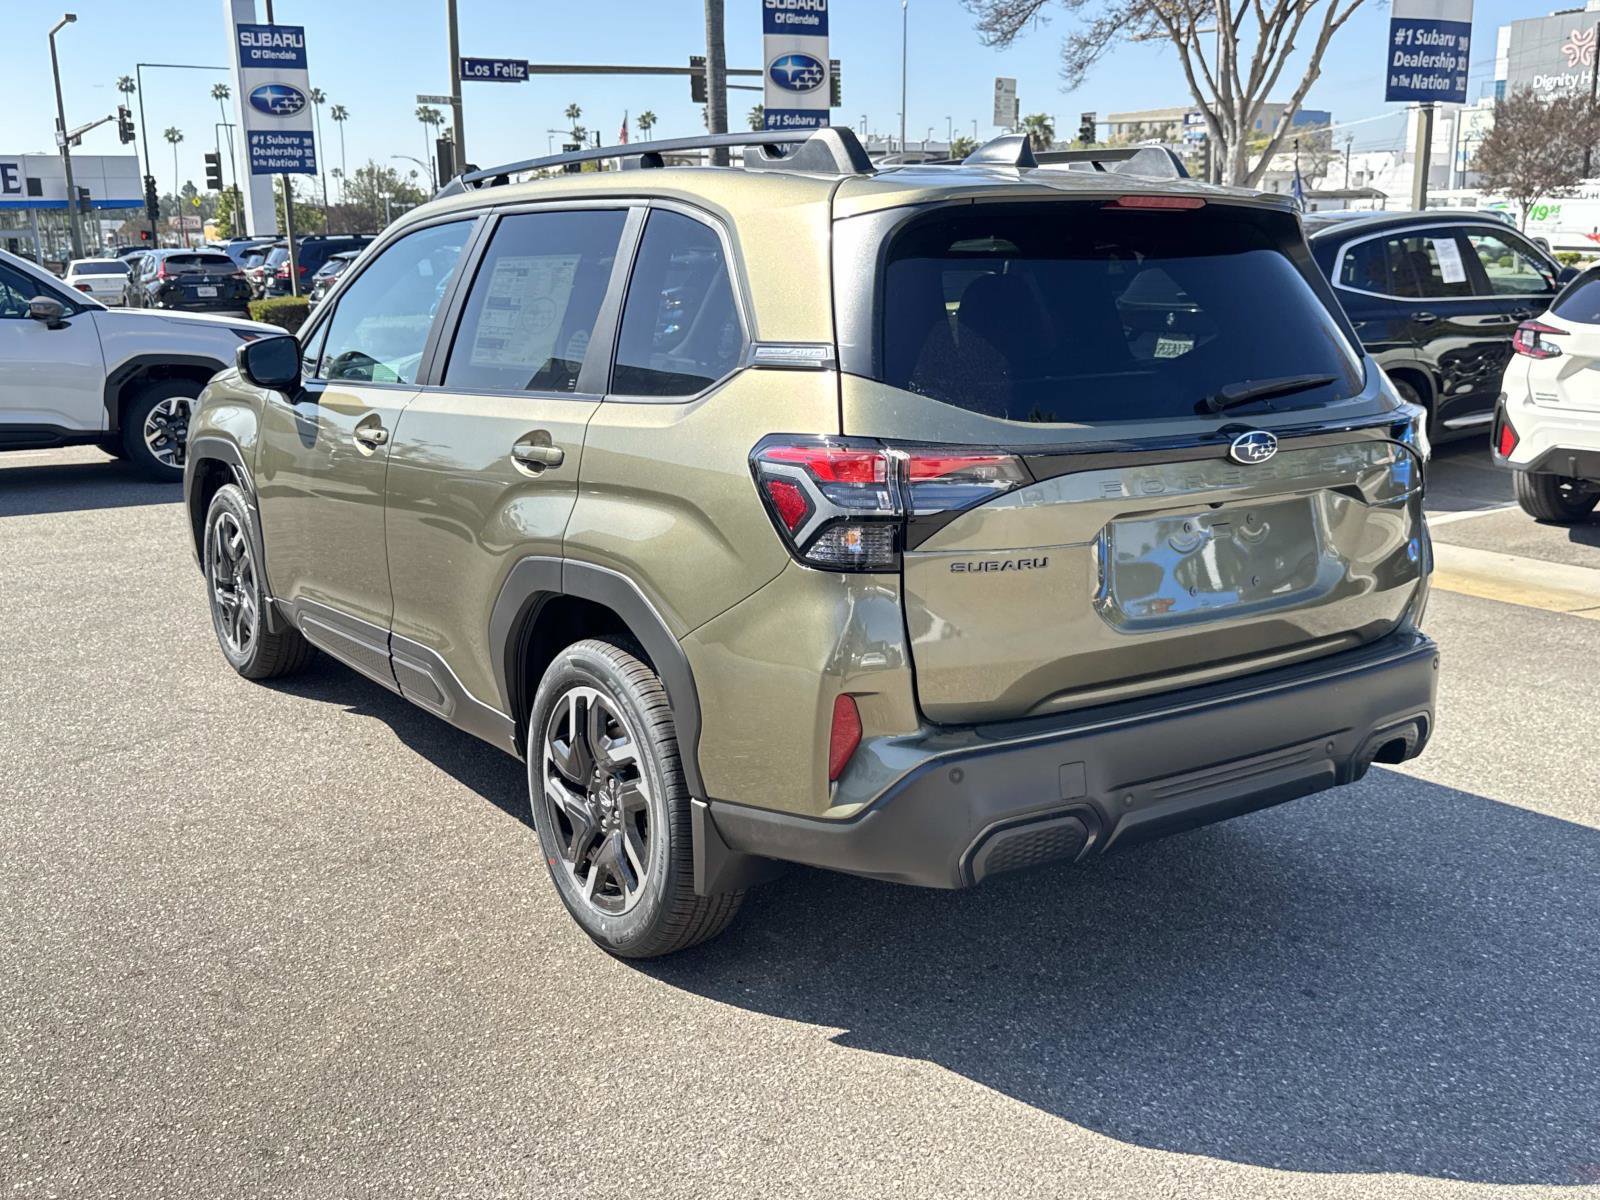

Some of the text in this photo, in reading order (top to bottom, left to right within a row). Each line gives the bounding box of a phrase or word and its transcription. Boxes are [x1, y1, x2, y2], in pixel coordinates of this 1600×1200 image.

[765, 0, 827, 11] SUBARU
[774, 12, 820, 26] Of Glendale
[240, 32, 304, 48] SUBARU
[1394, 28, 1413, 46] #1
[1414, 29, 1456, 47] Subaru
[251, 49, 297, 60] Of Glendale
[1392, 51, 1456, 73] Dealership
[464, 61, 525, 78] Los Feliz
[1410, 73, 1450, 90] Nation
[1532, 72, 1579, 92] Dignity
[767, 114, 781, 126] #1
[782, 114, 816, 126] Subaru
[252, 135, 264, 145] #1
[266, 135, 300, 145] Subaru
[253, 146, 303, 158] Dealership
[268, 158, 300, 167] Nation
[1099, 453, 1374, 498] FORESTE
[950, 557, 1049, 574] SUBARU
